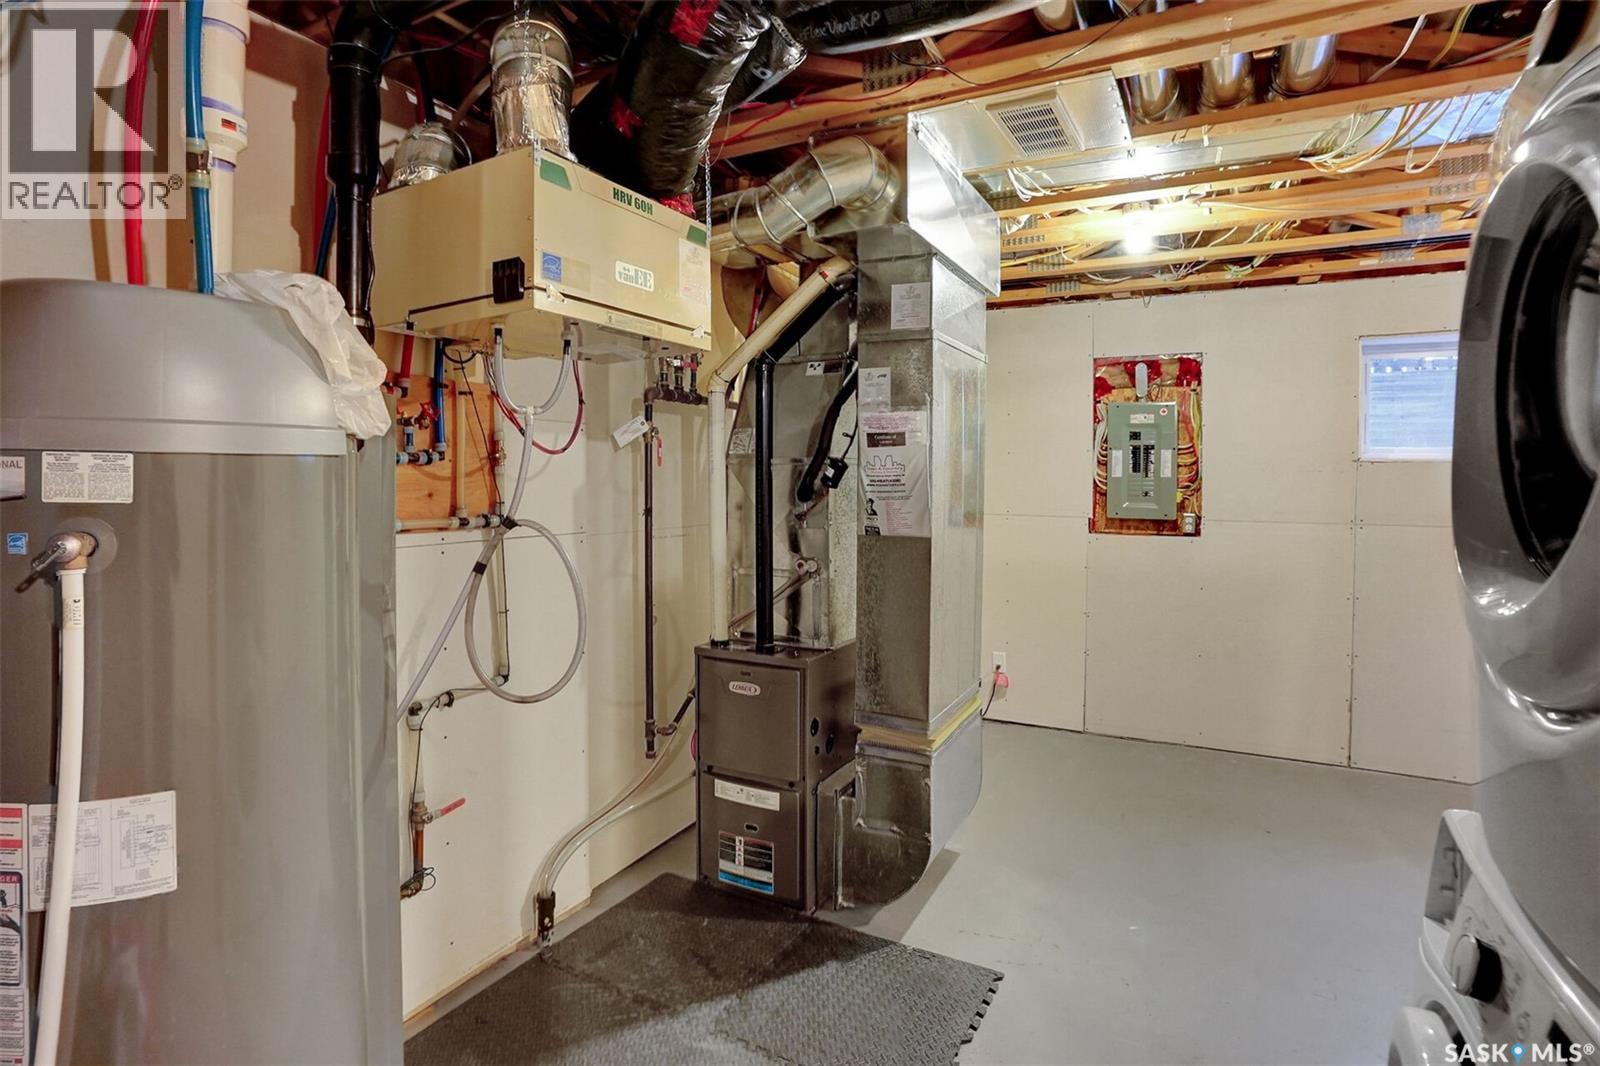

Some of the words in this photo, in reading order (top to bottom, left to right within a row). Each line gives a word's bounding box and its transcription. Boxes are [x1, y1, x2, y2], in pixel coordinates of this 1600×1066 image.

[612, 187, 633, 207] HRV
[634, 197, 653, 216] 60H
[0, 460, 23, 469] NAL
